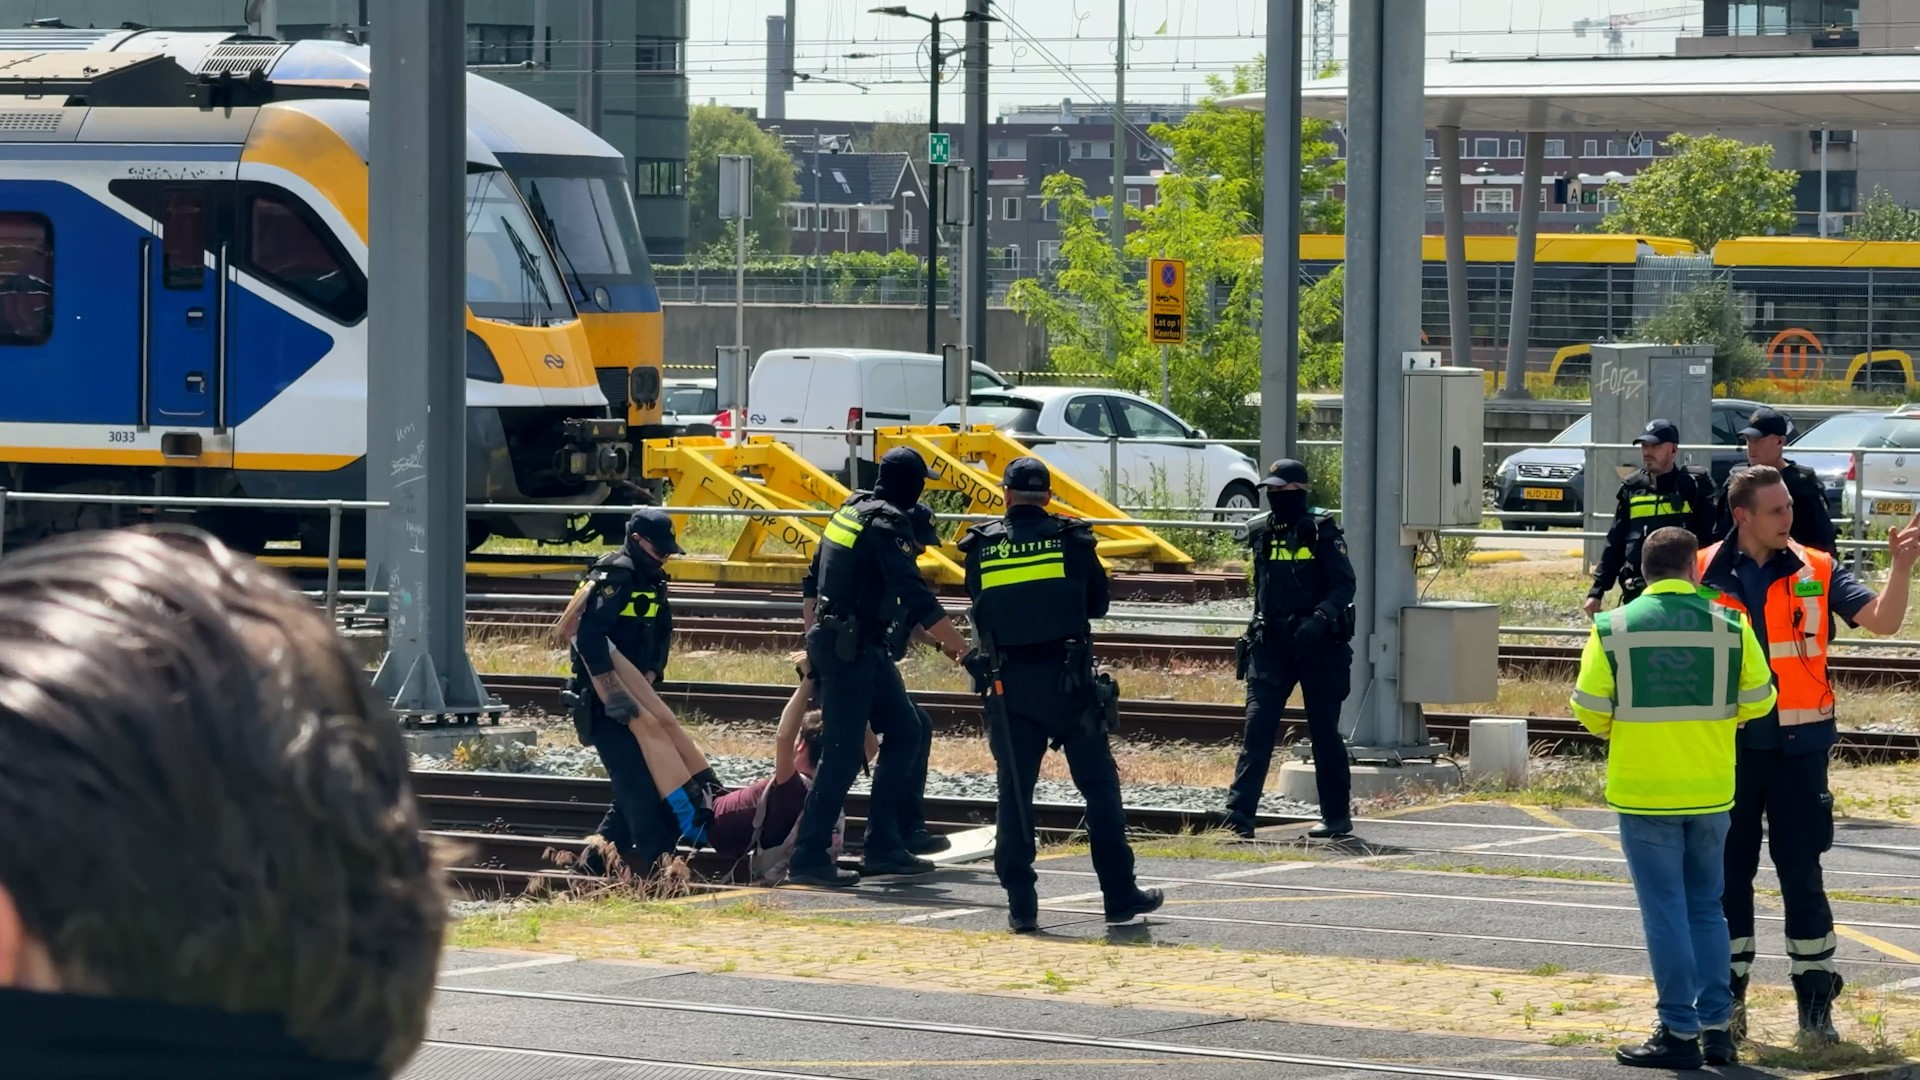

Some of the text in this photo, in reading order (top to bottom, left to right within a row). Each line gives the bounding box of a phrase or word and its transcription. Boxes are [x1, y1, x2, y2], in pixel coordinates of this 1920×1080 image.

[1570, 188, 1579, 202] A
[1155, 318, 1166, 326] Let
[1167, 320, 1176, 328] op
[108, 431, 135, 443] 3033
[782, 526, 813, 557] OK
